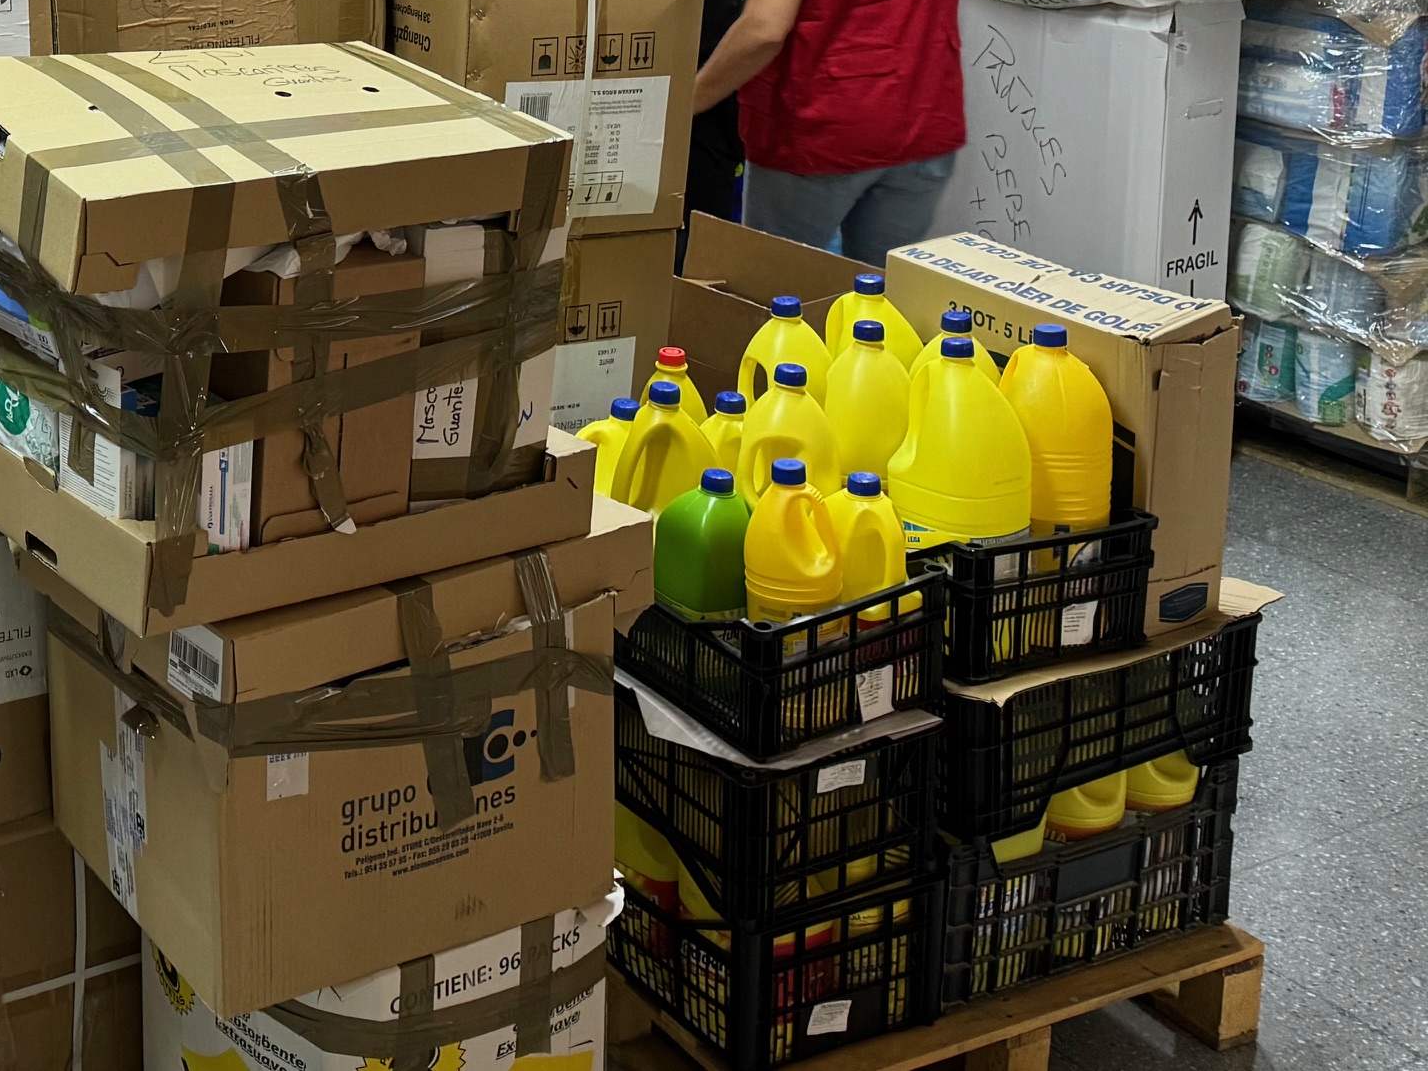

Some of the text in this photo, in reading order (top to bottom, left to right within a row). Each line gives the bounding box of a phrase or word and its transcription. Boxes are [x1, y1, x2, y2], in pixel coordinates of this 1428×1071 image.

[900, 246, 932, 261] NO
[931, 255, 998, 285] DEJAR
[993, 278, 1054, 306] CAER
[1050, 296, 1082, 315] DE
[1166, 249, 1219, 279] FRAGIL
[1003, 321, 1014, 339] 5
[5, 668, 19, 679] LXD
[341, 783, 417, 826] grupo
[389, 965, 494, 1016] CONTIENE:
[498, 951, 521, 976] 96
